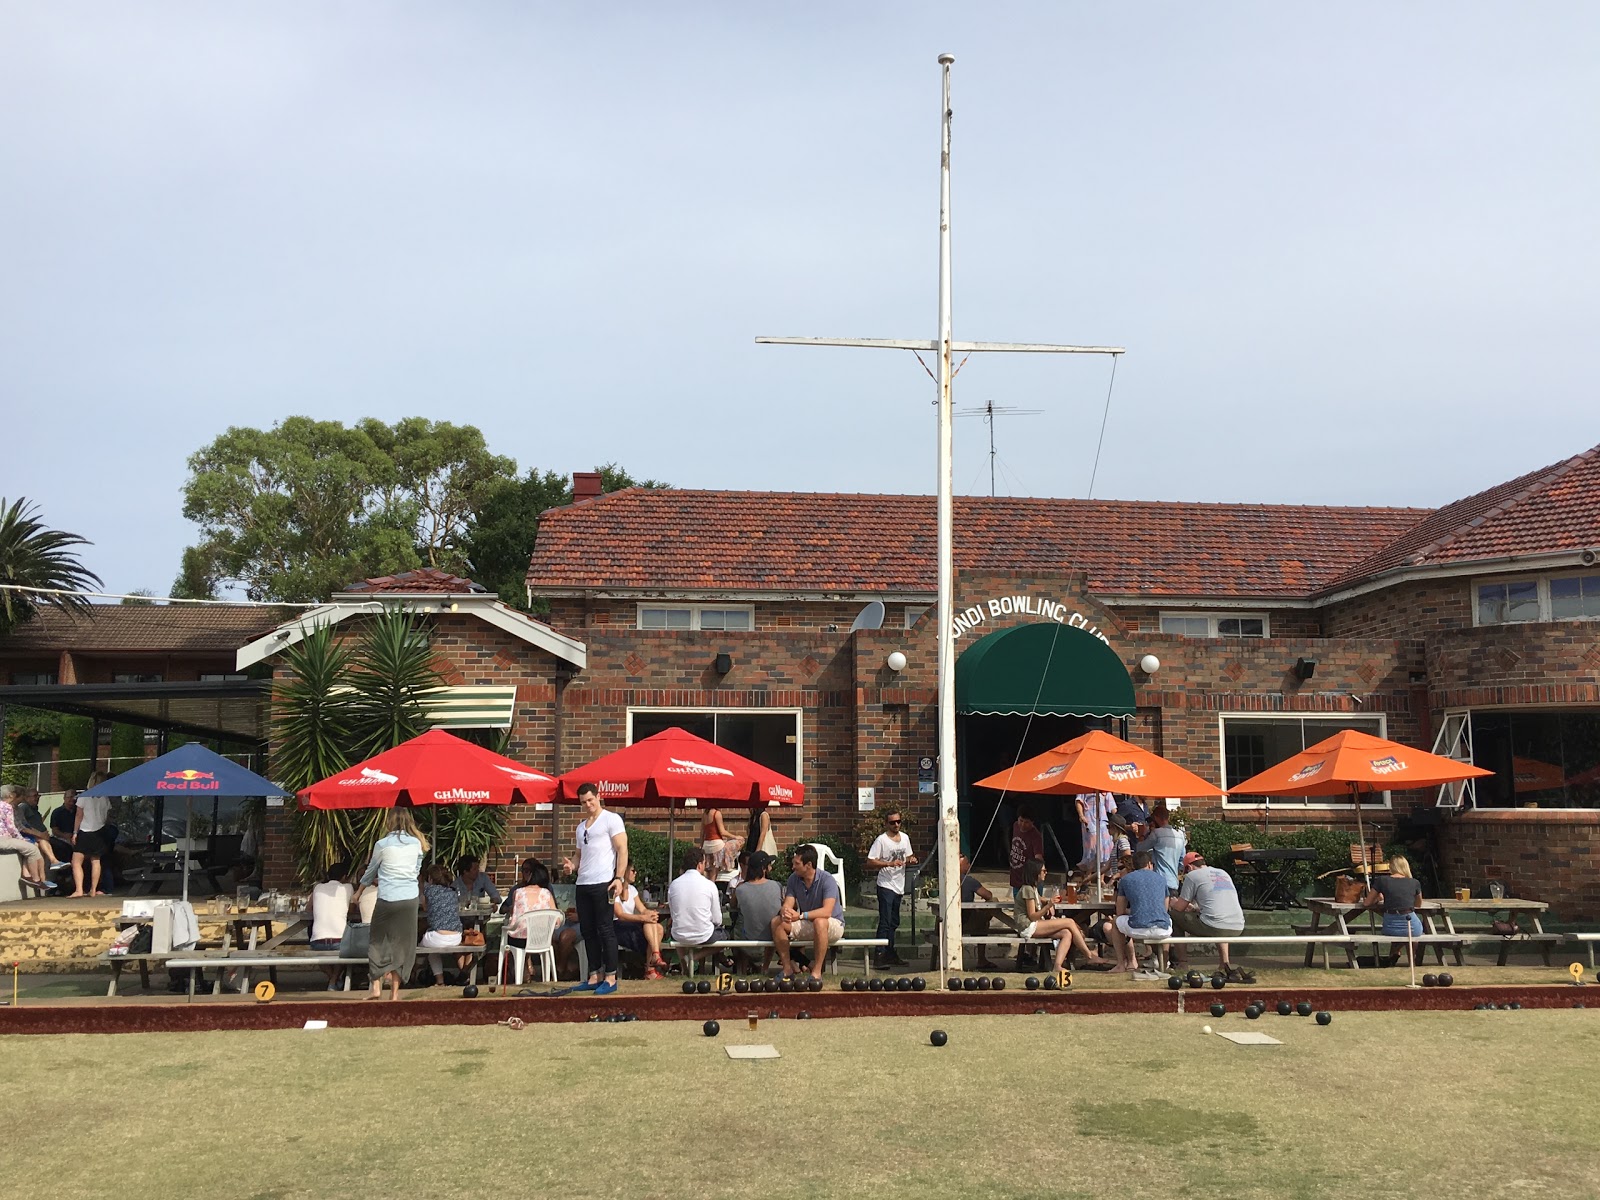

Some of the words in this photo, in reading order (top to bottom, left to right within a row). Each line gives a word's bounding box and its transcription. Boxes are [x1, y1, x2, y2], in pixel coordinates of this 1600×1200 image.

[937, 604, 986, 639] ONDI
[988, 596, 1067, 623] BOWLING
[1108, 769, 1147, 782] Spritz
[157, 781, 188, 790] Red
[190, 781, 219, 790] Bull
[594, 780, 630, 792] MUMM
[1059, 971, 1071, 988] 13
[261, 985, 269, 997] 7
